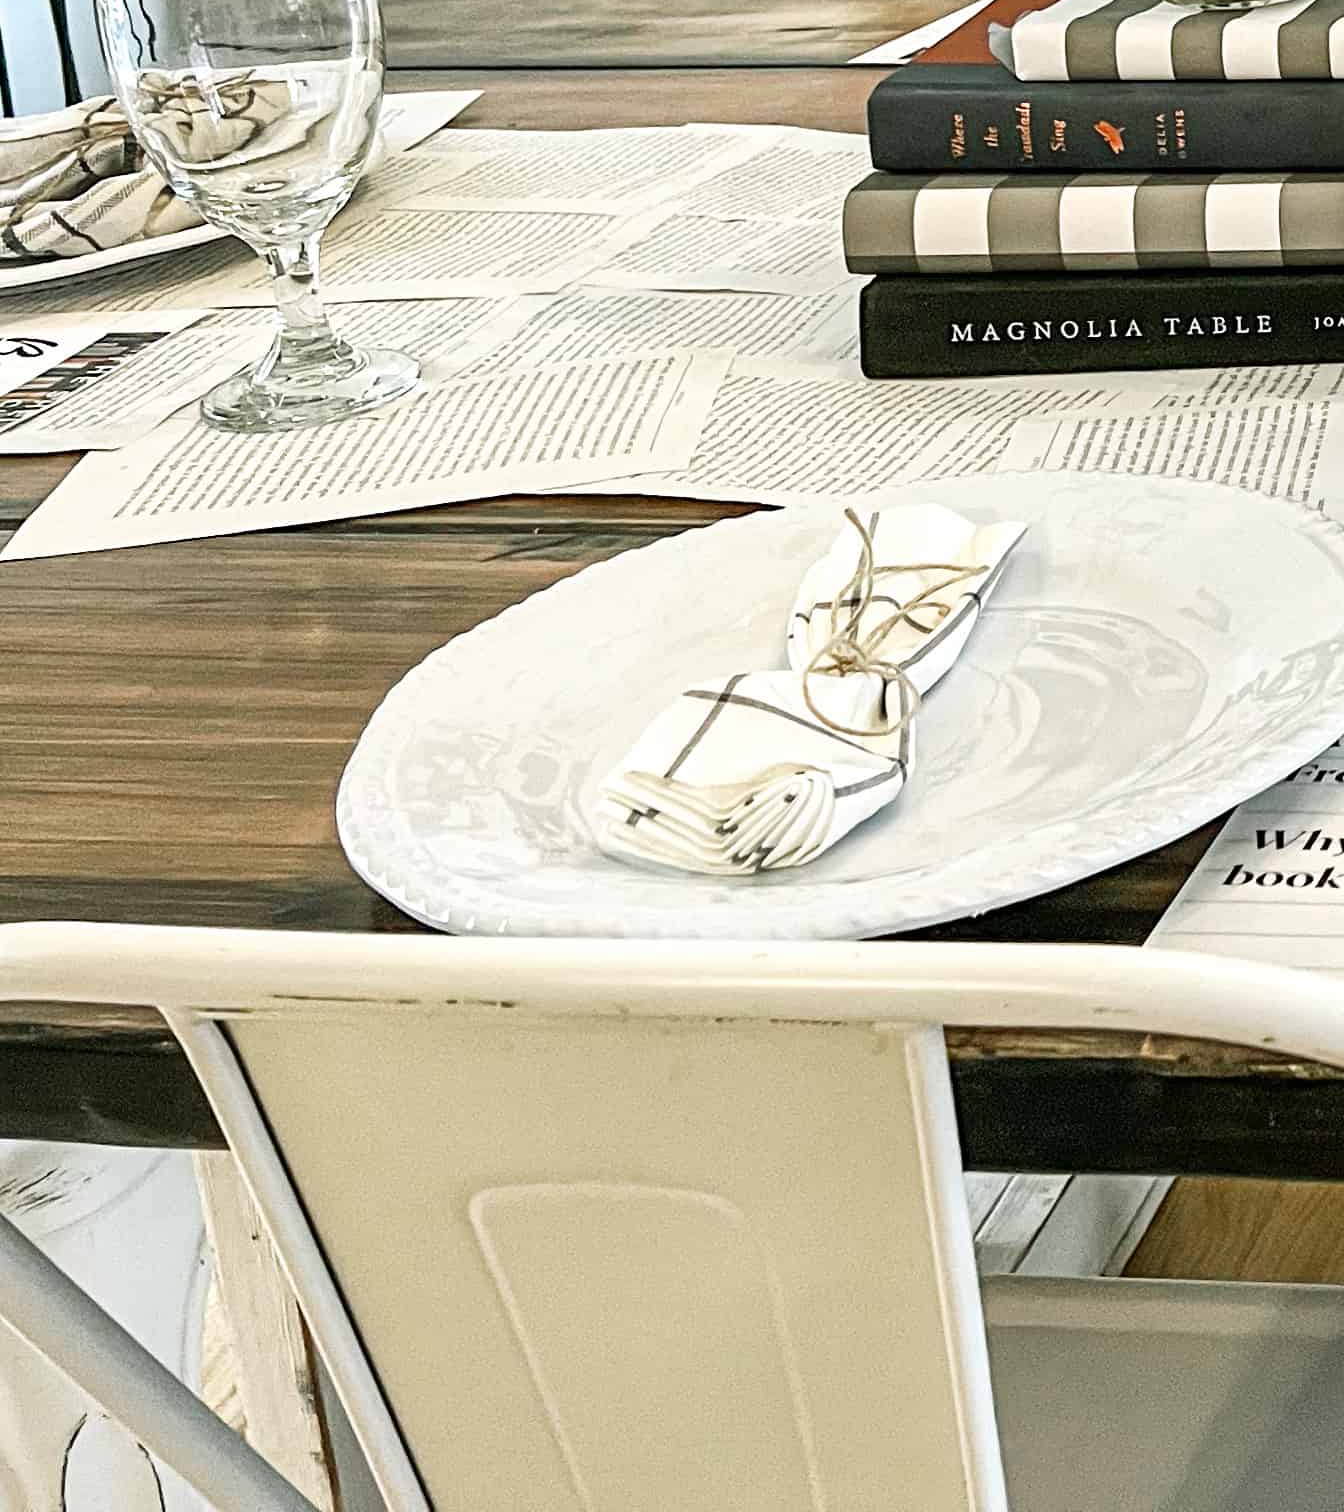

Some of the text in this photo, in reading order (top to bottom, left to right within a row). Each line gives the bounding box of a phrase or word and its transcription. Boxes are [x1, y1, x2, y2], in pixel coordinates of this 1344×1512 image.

[983, 124, 999, 148] the
[1050, 119, 1067, 153] Sing
[1155, 112, 1168, 156] DELIA
[951, 315, 1275, 344] MAGNOLIA TABLE
